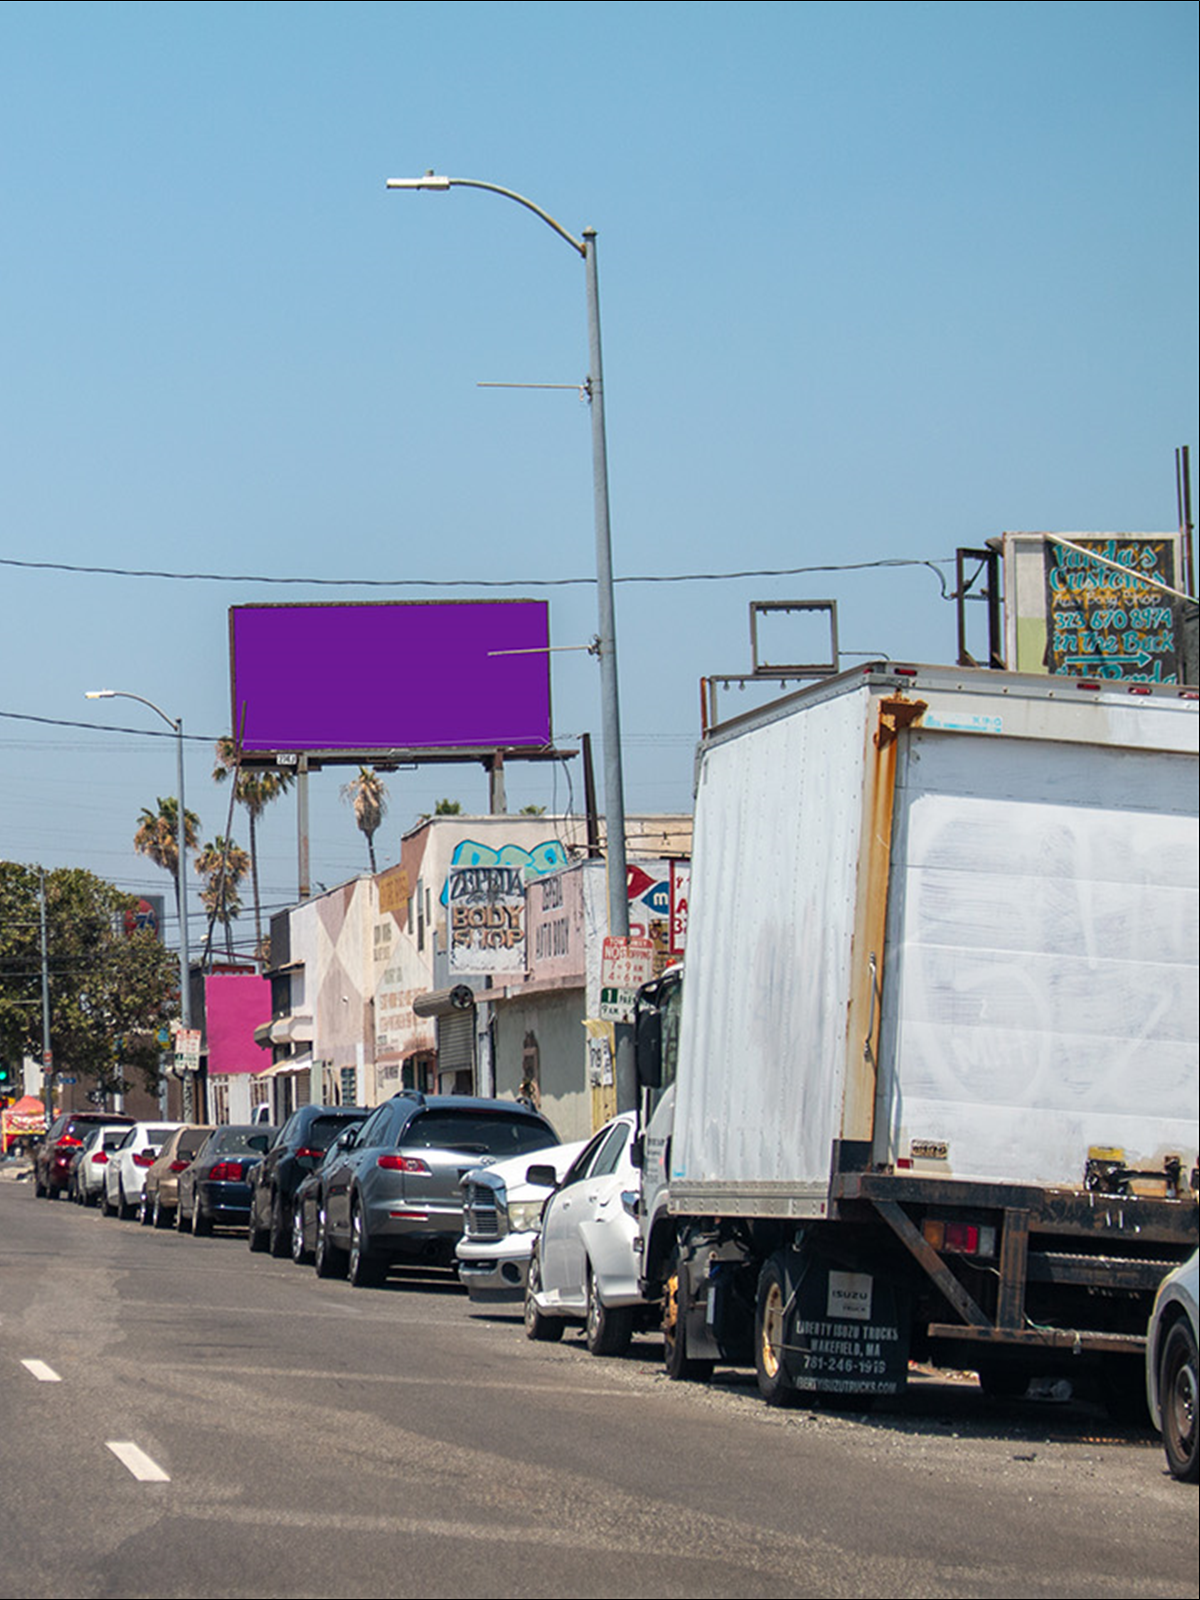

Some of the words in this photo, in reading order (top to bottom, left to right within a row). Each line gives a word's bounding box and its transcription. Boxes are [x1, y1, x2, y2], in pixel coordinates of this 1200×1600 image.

[1050, 567, 1167, 591] Customs
[1086, 590, 1118, 609] Body
[1122, 590, 1162, 606] Shop
[1054, 611, 1086, 630] 323
[1091, 610, 1127, 629] 670
[1129, 608, 1172, 629] 8974
[1053, 631, 1077, 652] in
[1078, 631, 1119, 652] The
[1122, 630, 1175, 653] Back
[452, 904, 525, 930] BODY
[452, 929, 525, 950] SHOP
[604, 946, 619, 959] NO
[625, 961, 631, 970] 9
[624, 973, 630, 982] 6
[832, 1290, 868, 1300] ISUZU
[796, 1320, 833, 1336] LIBERTY
[833, 1323, 860, 1339] ISUZU
[862, 1326, 899, 1341] TRUCKS
[810, 1339, 864, 1357] WAKEFIELD,
[865, 1343, 881, 1357] MA
